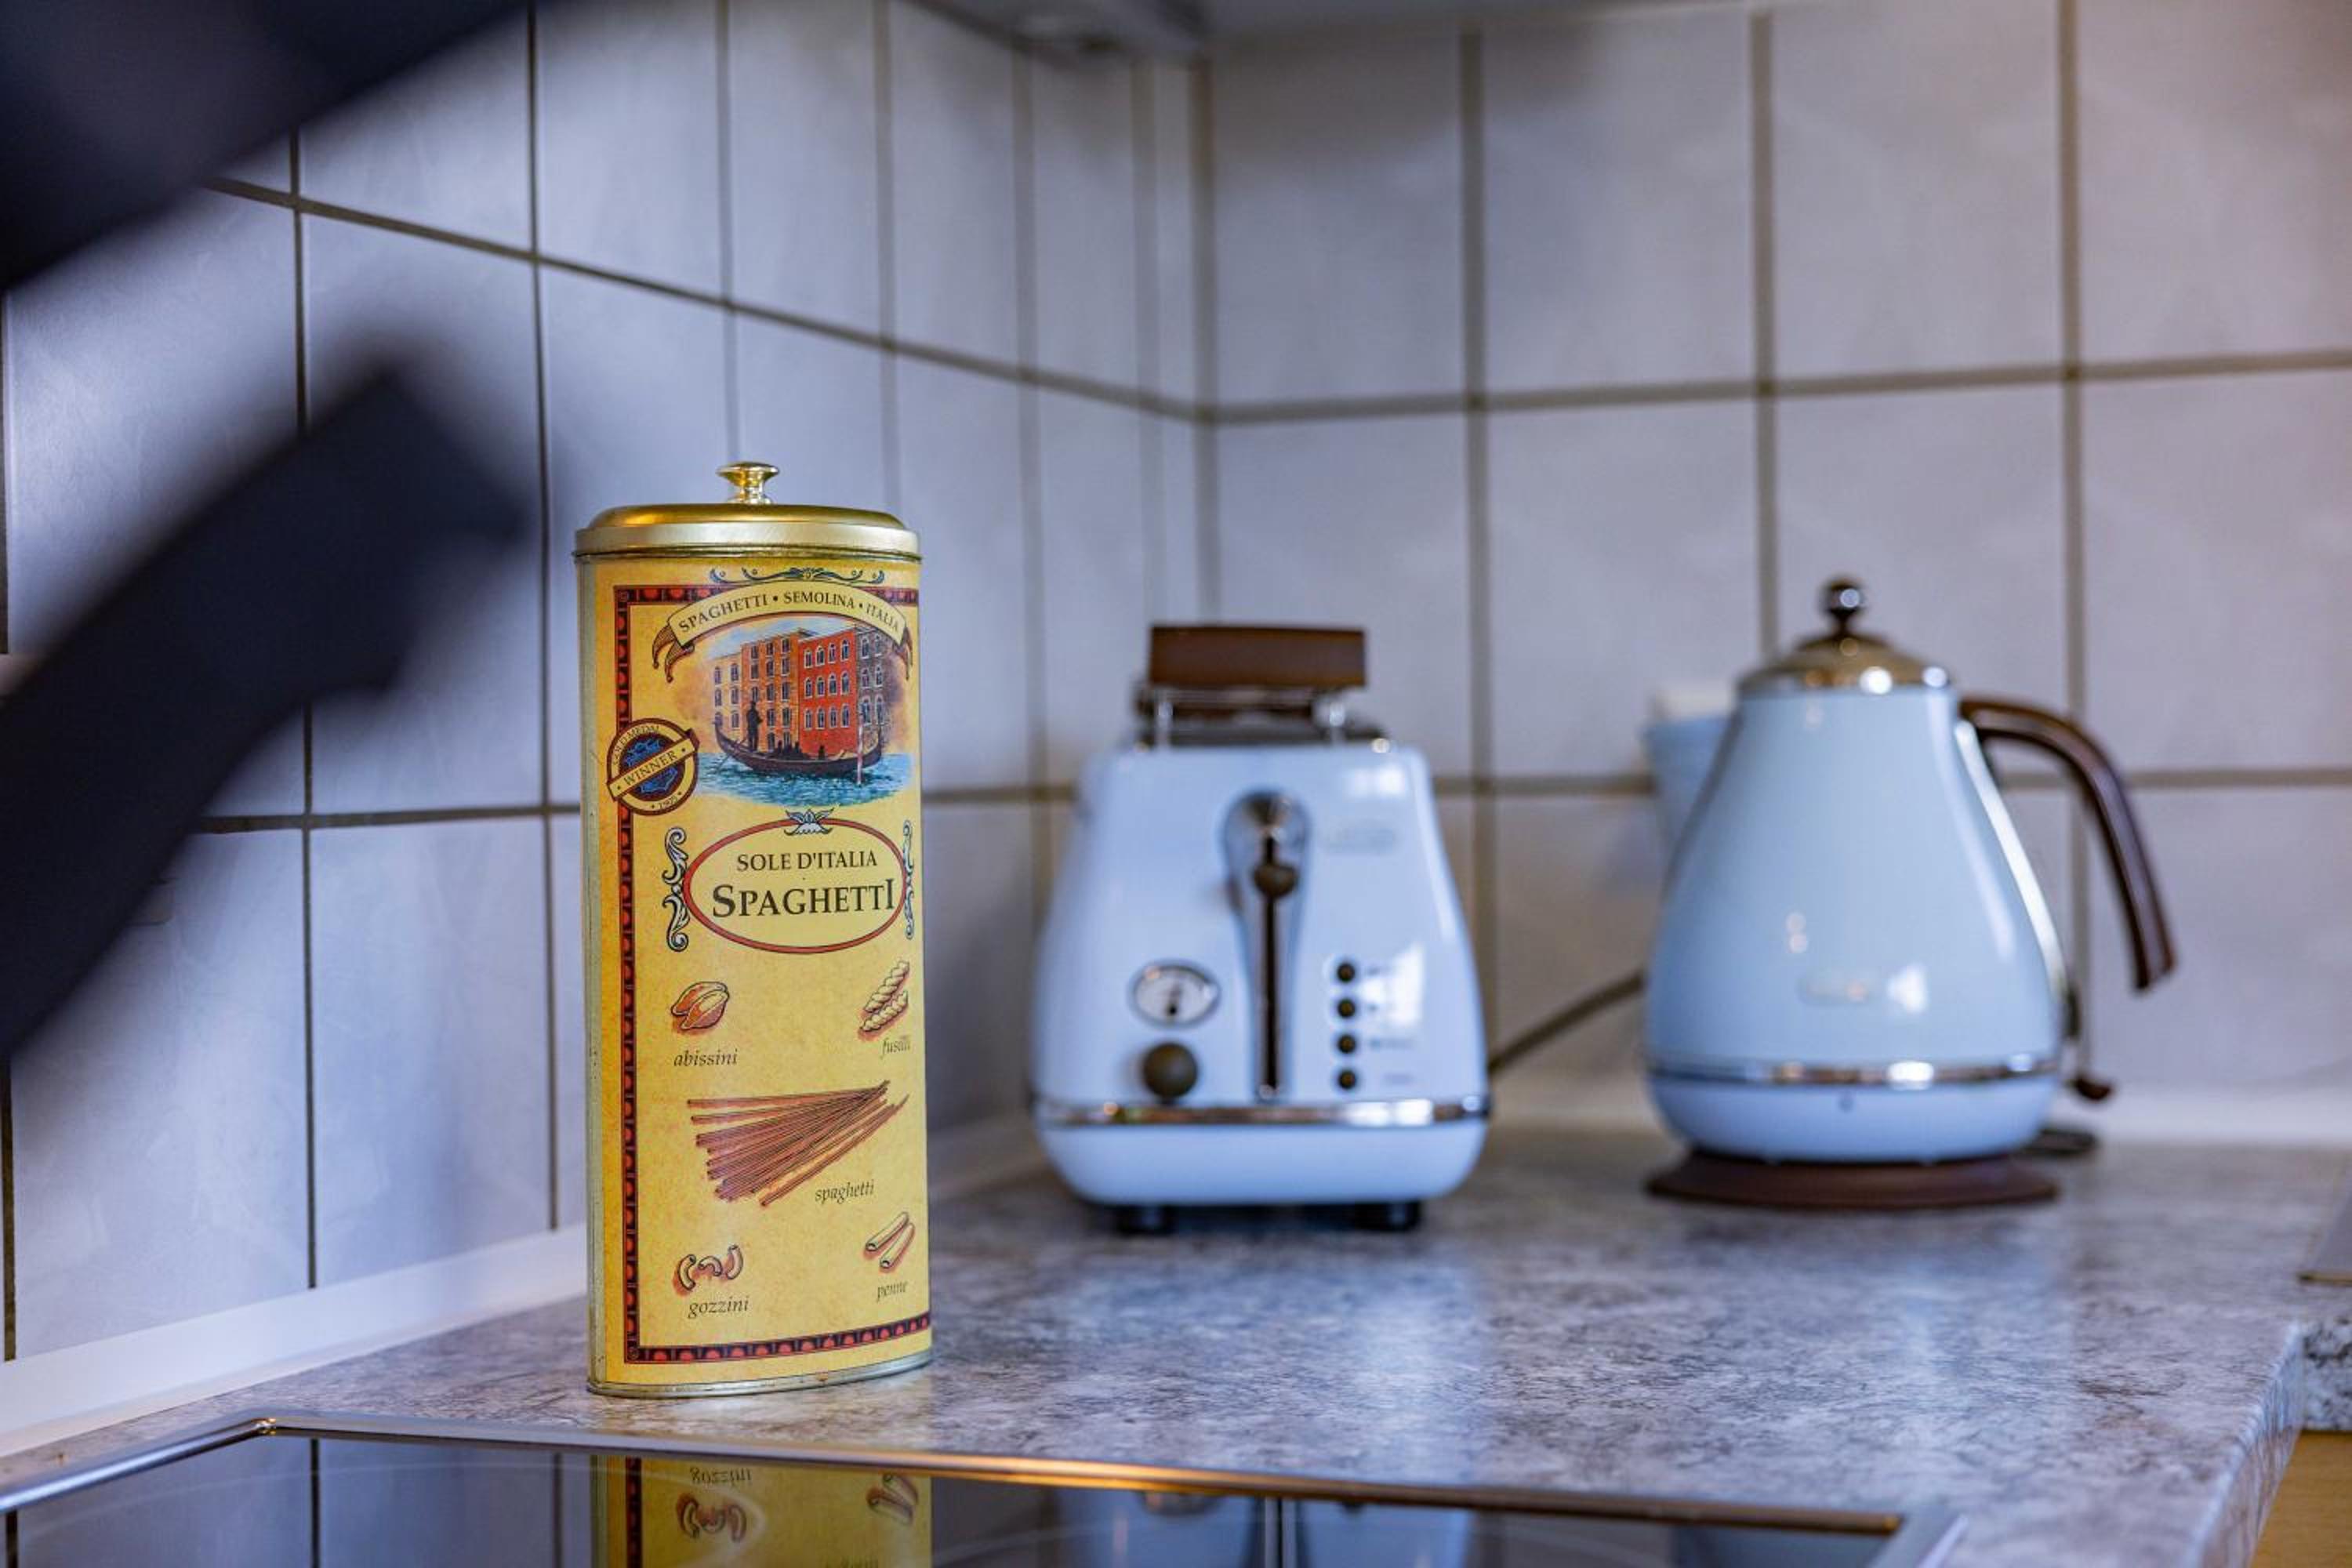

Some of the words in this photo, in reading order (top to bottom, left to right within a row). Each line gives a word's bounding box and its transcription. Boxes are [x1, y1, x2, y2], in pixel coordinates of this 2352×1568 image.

[678, 593, 768, 633] SPAGHETTI
[784, 591, 855, 609] SEMOLINA
[866, 603, 898, 632] ITALIA
[623, 750, 678, 786] WINNER
[736, 853, 791, 872] SOLE
[797, 850, 877, 869] D'ITALIA
[712, 878, 895, 918] SPAGHETTI
[673, 1048, 739, 1067] abissini
[815, 1178, 875, 1205] spaghetti
[688, 1295, 750, 1319] gozzini
